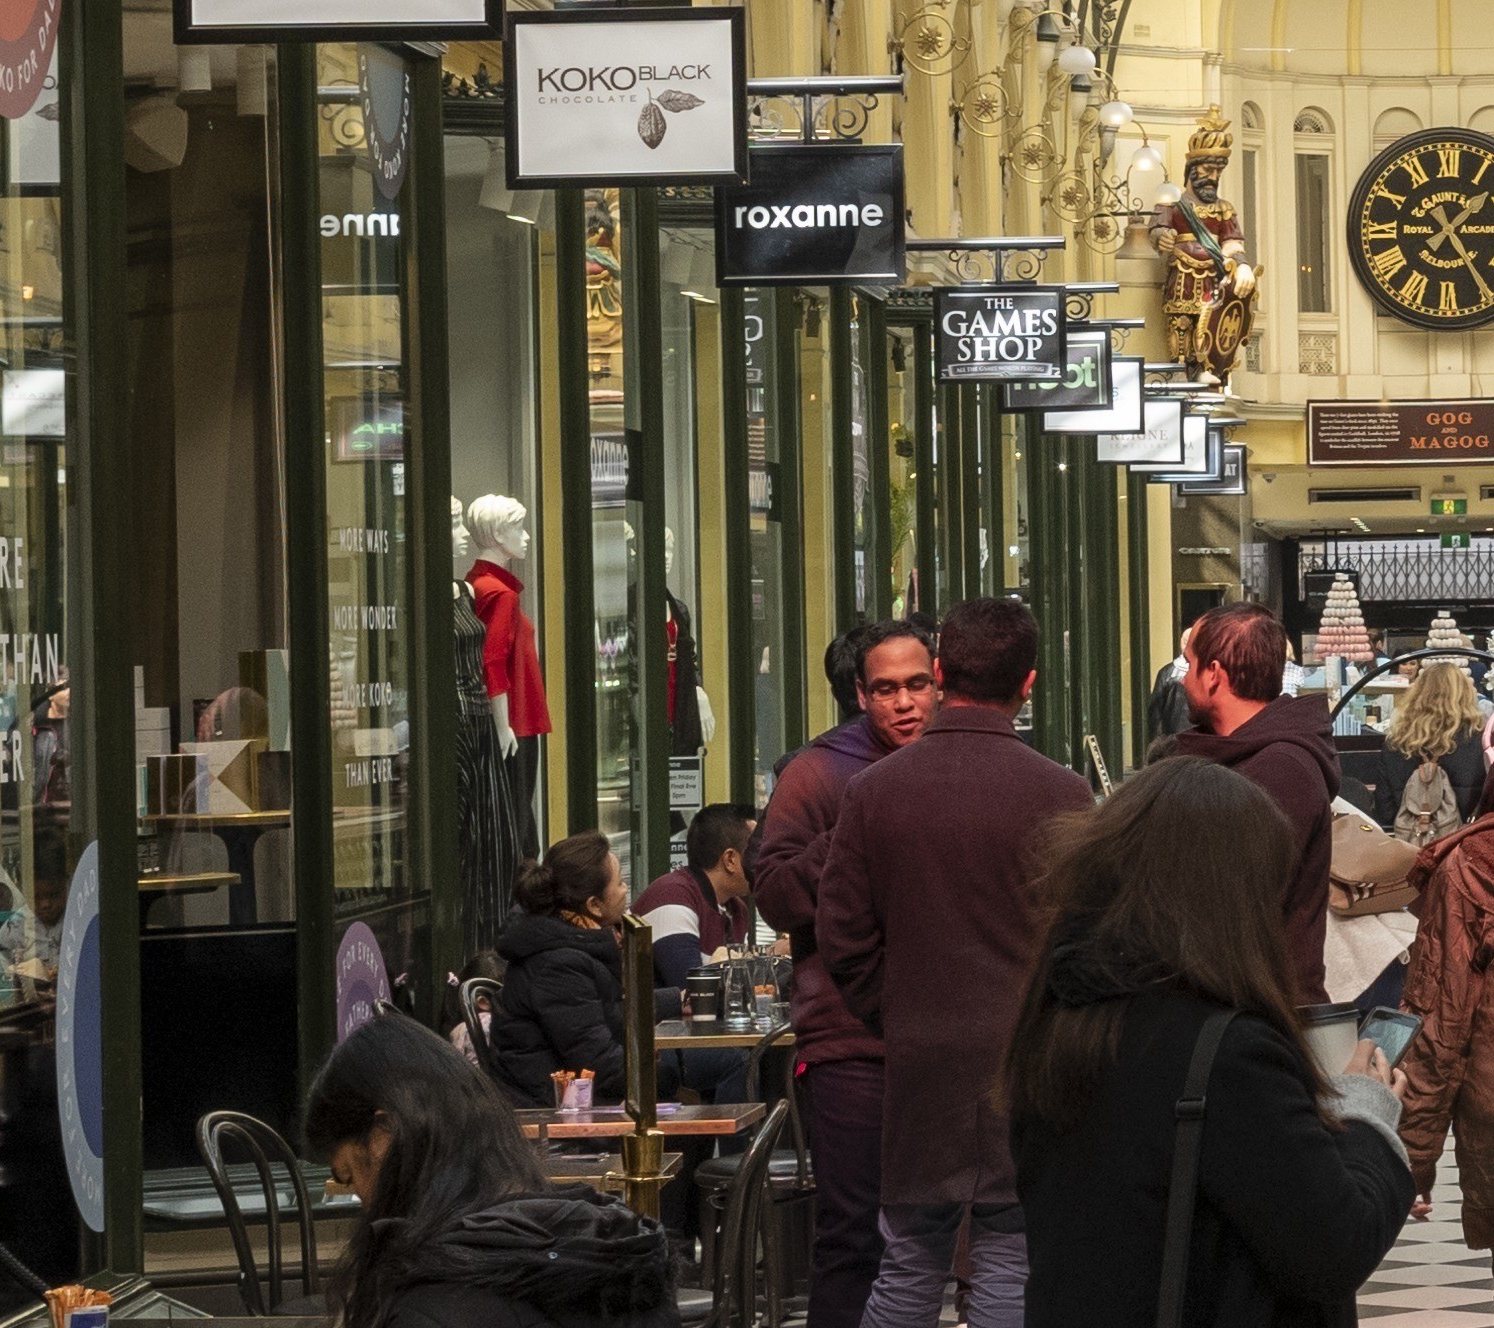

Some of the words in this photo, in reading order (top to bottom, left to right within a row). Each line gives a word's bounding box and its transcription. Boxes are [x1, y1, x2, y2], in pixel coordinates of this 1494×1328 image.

[17, 49, 38, 91] FOR
[537, 66, 637, 93] KOKO
[638, 63, 712, 81] BLACK
[538, 95, 637, 105] CHOCOLATE
[733, 199, 884, 230] roxanne
[1403, 225, 1434, 234] ROYAL
[1419, 249, 1478, 268] MELBOURE.
[984, 298, 1014, 310] THE
[942, 309, 1057, 337] GAMES
[957, 337, 1043, 362] SHOP
[1426, 412, 1473, 426] GOG
[1409, 435, 1490, 449] MAGOG
[339, 527, 364, 552] MORE
[366, 529, 389, 554] WAYS
[333, 605, 358, 630] MORE
[361, 605, 397, 630] WONDER
[343, 682, 366, 707] MORE
[369, 681, 393, 706] KOKO
[345, 761, 369, 788] THAN
